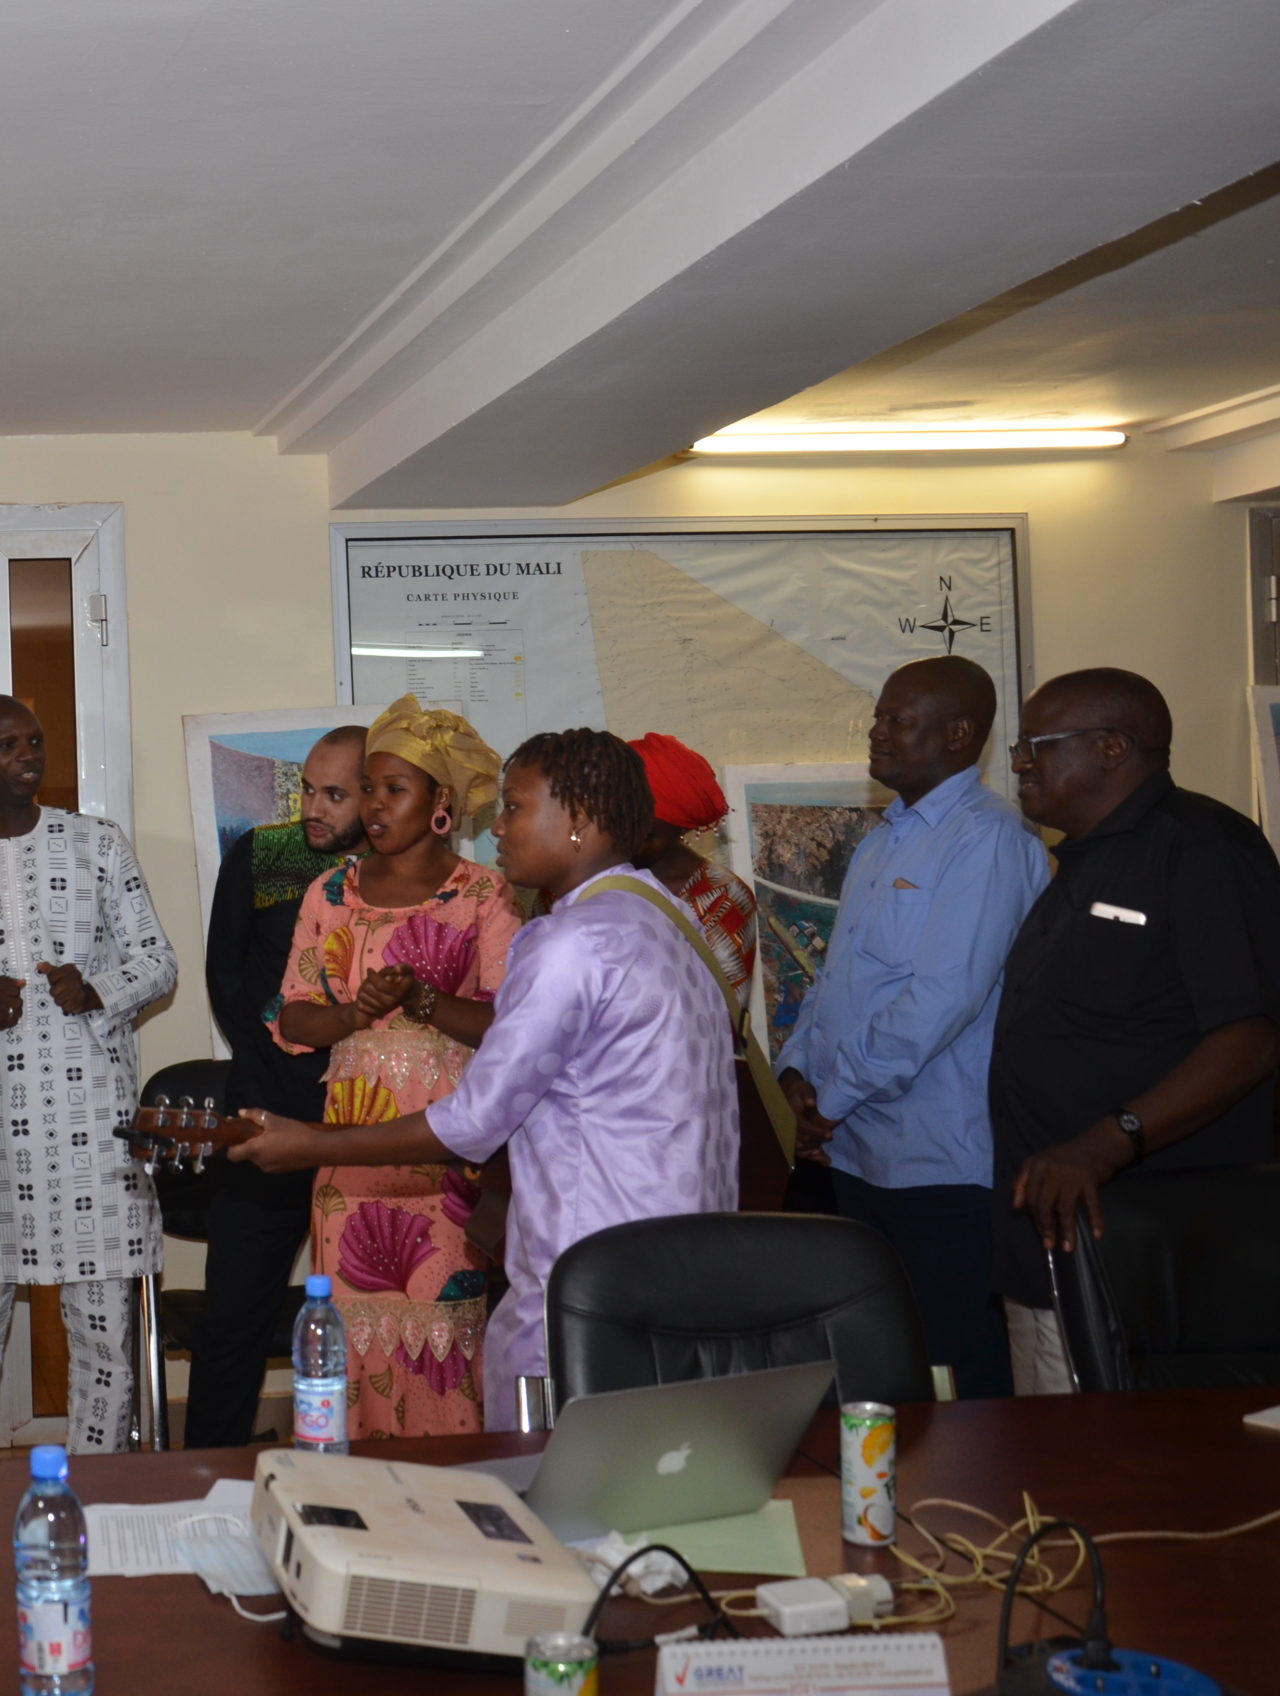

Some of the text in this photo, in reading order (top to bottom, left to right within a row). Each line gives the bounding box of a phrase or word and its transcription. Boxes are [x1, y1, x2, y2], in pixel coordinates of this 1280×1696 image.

[360, 561, 563, 580] RÉPUBLIQUE DU MALI
[939, 575, 952, 592] N
[406, 591, 520, 603] CARTE PHYSIQUE
[897, 616, 993, 634] W E
